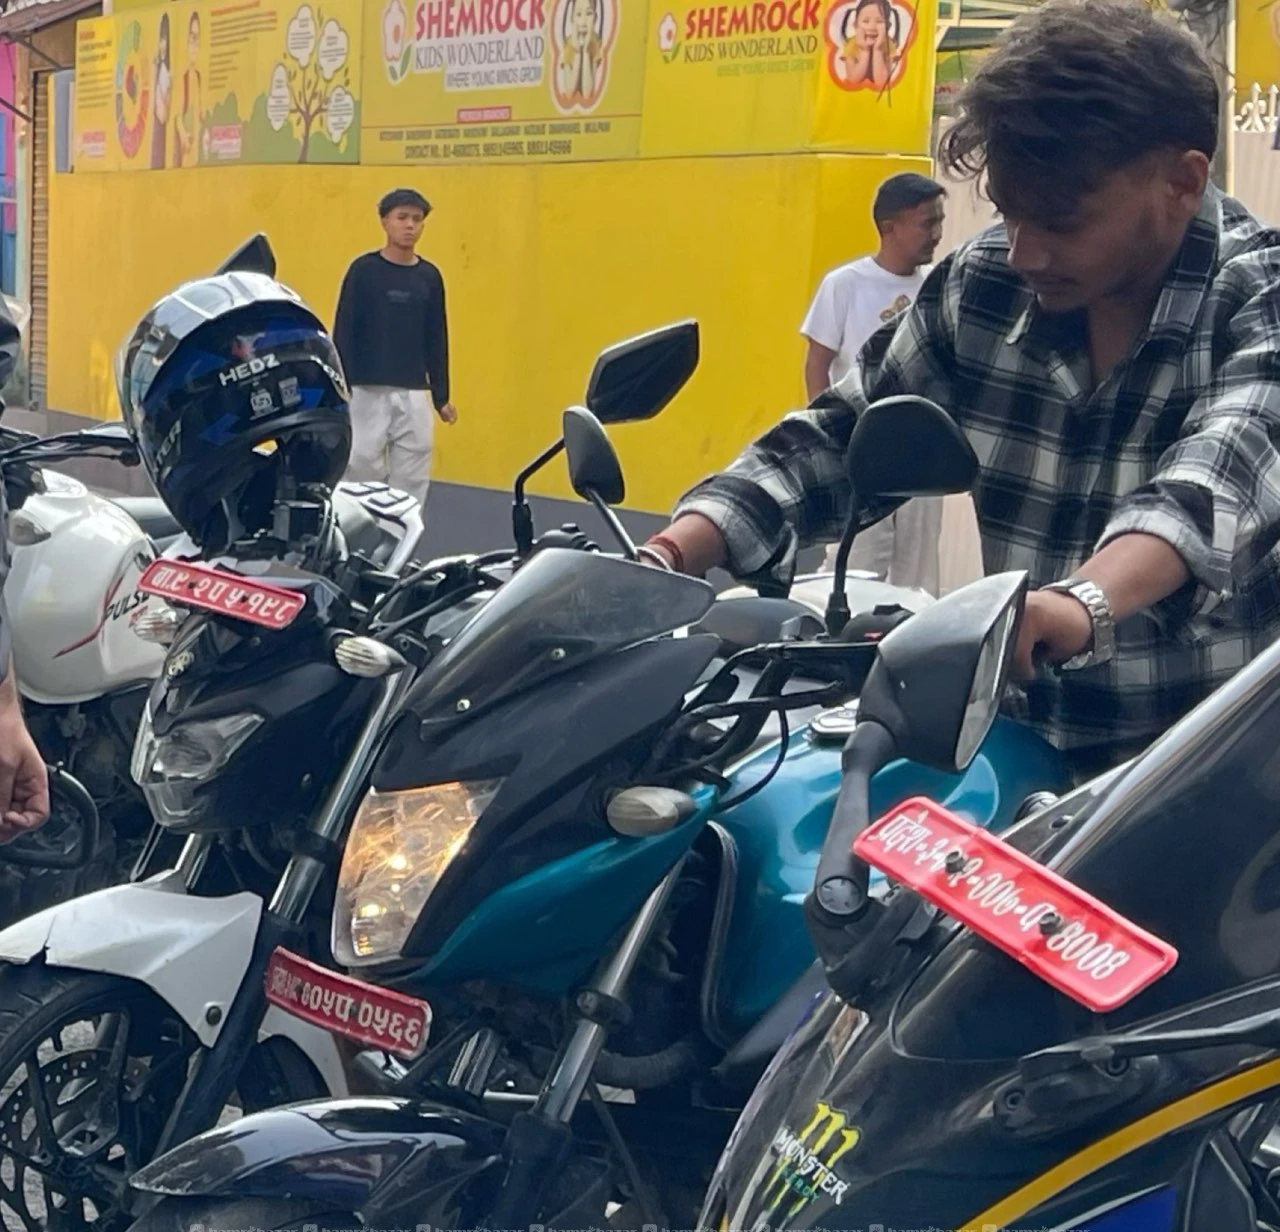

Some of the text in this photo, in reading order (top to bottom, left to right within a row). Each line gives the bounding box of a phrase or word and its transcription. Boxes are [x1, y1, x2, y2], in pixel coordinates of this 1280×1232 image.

[415, 0, 545, 40] SHEMROCK
[685, 0, 820, 40] SHEMROCK
[415, 36, 545, 71] KIDS WONDERLAND
[684, 34, 818, 63] KIDS WONDERLAND
[219, 353, 280, 386] HEDZ
[774, 1126, 850, 1205] MONSTER
